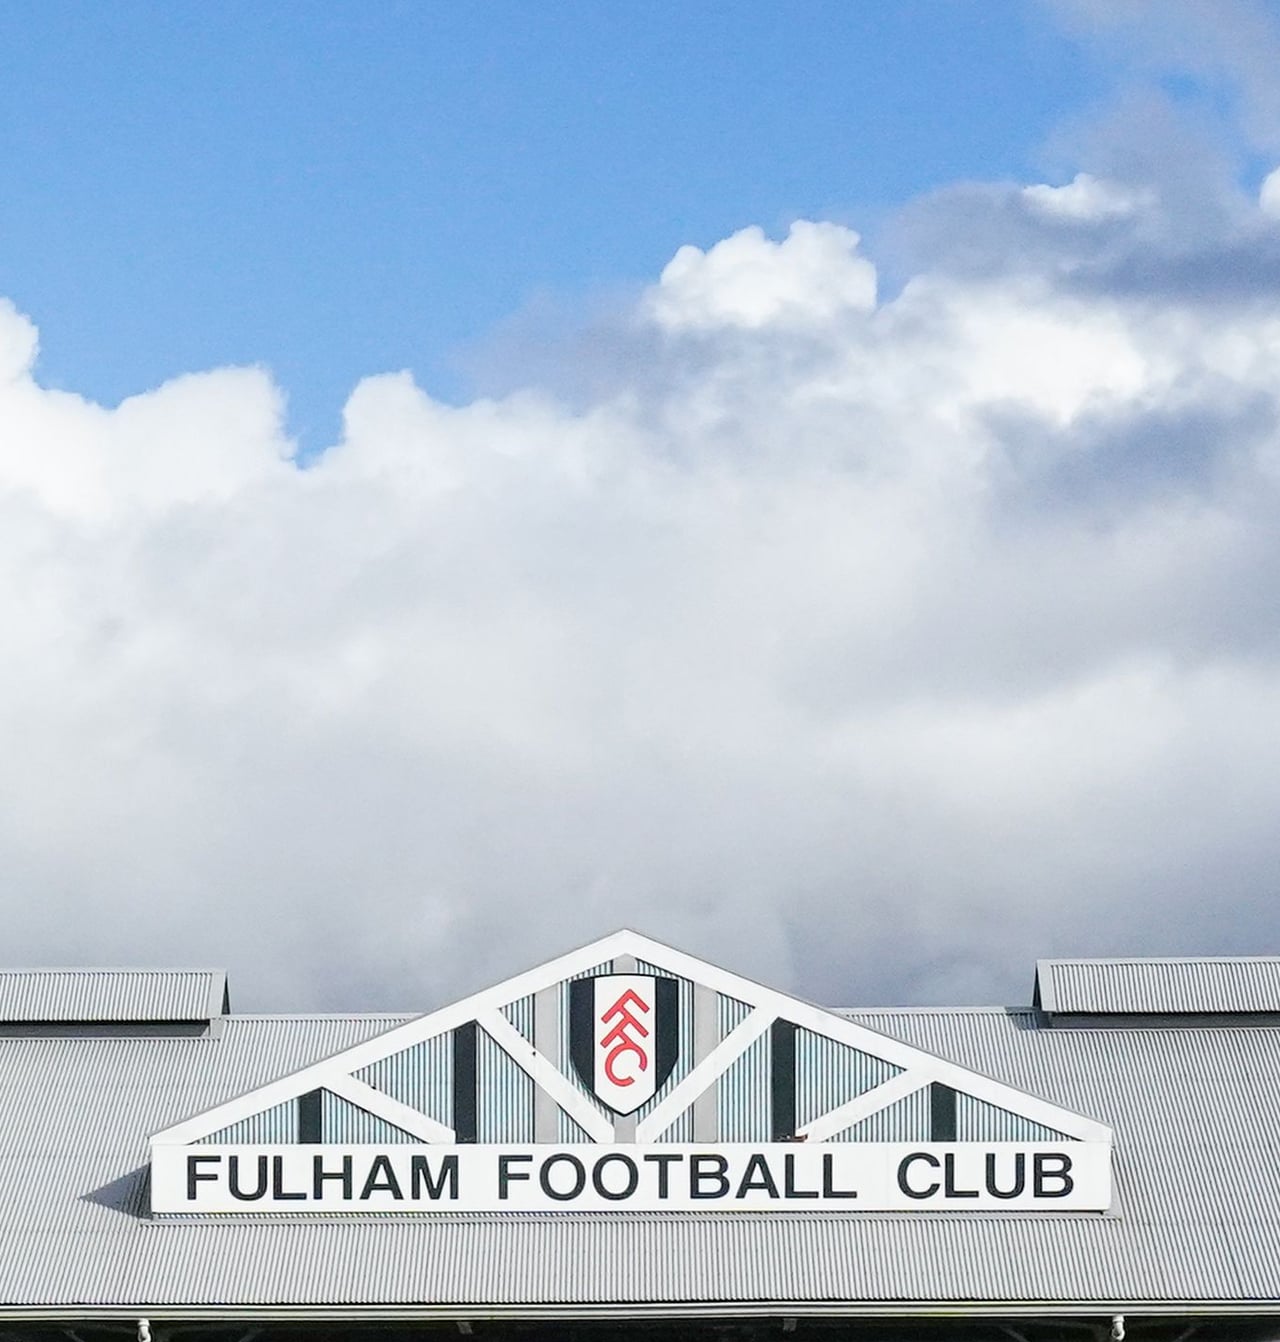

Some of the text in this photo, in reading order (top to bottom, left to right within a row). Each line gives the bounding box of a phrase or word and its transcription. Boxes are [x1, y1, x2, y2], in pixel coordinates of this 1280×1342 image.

[600, 988, 650, 1087] FFC
[186, 1152, 1075, 1202] FULHAM FOOTBALL CLUB
